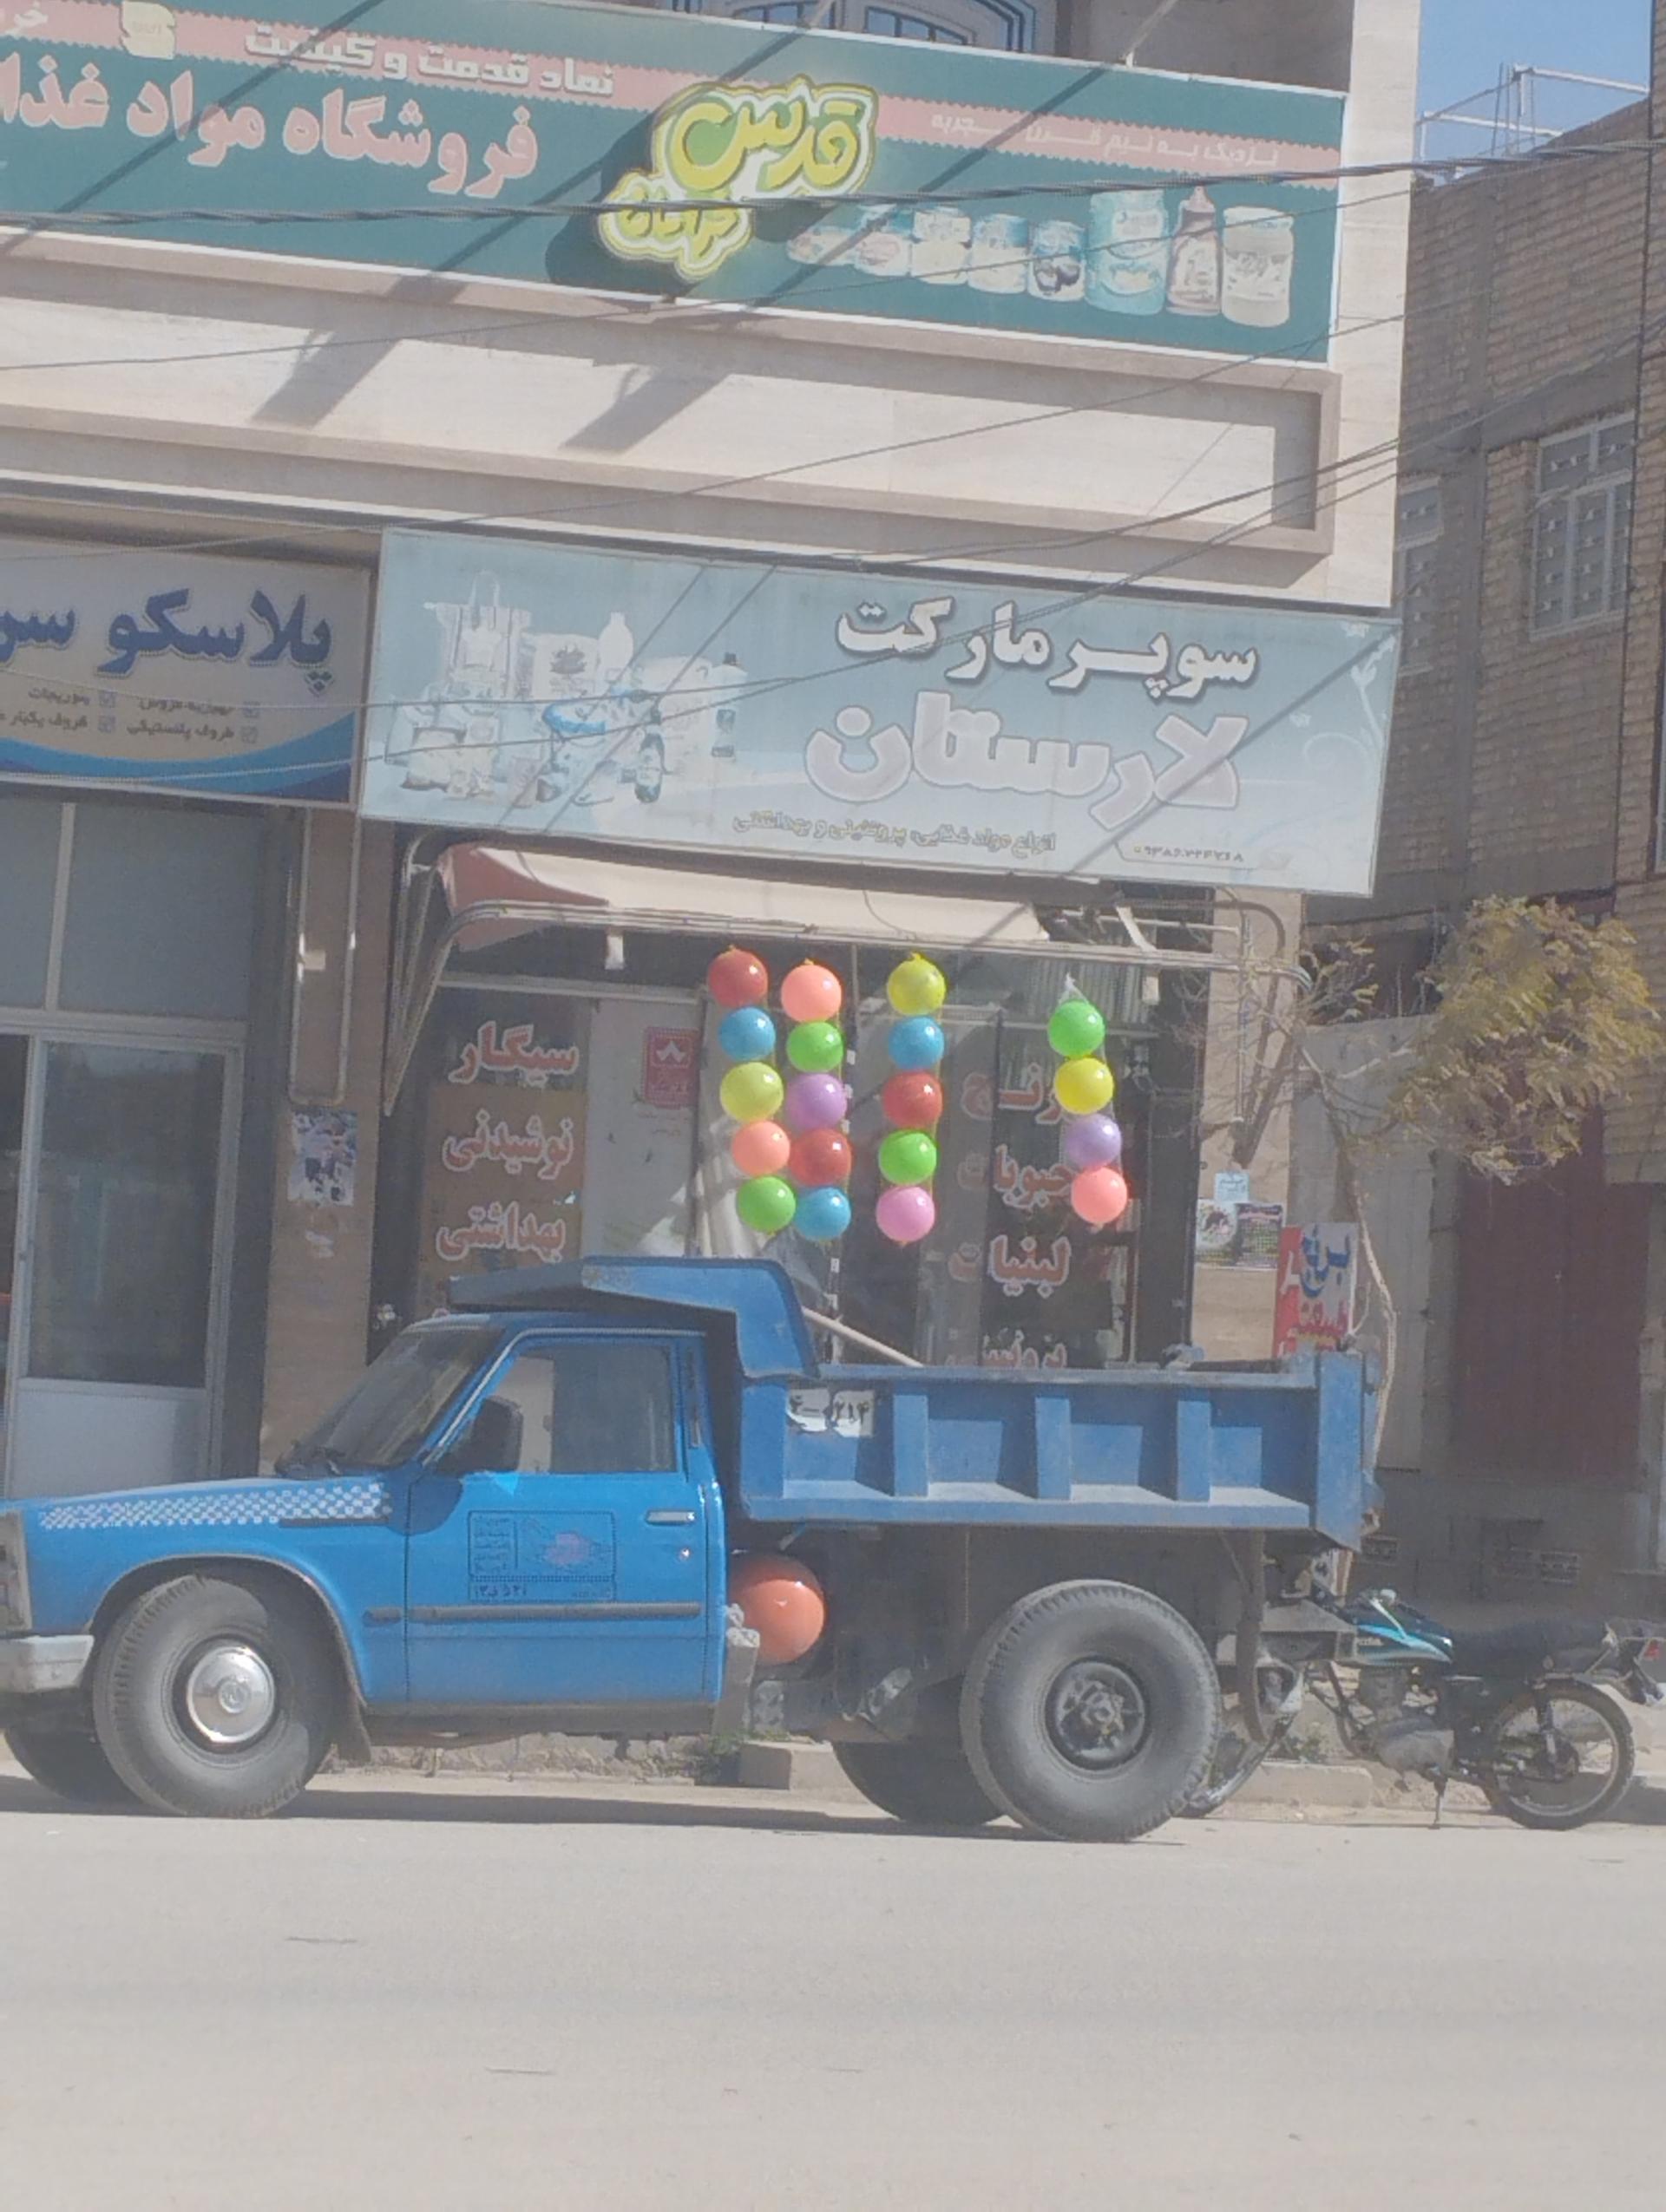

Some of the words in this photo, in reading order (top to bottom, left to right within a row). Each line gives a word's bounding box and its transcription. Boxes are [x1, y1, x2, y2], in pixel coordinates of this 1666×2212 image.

[245, 24, 377, 71] کیفیت
[382, 52, 409, 80] و
[417, 43, 530, 87] قدمت
[539, 56, 615, 97] نماد
[126, 69, 266, 167] مواد
[282, 87, 538, 199] فروشگاه
[670, 99, 859, 193] قدس
[95, 587, 334, 694] پلاسکو
[835, 596, 1051, 684] مارکت
[1047, 632, 1258, 701] سوپر
[803, 690, 1251, 833] لارستان
[447, 1019, 580, 1085] سیگار
[441, 1108, 574, 1181] نوشیدنی
[436, 1200, 566, 1264] بهداشتی
